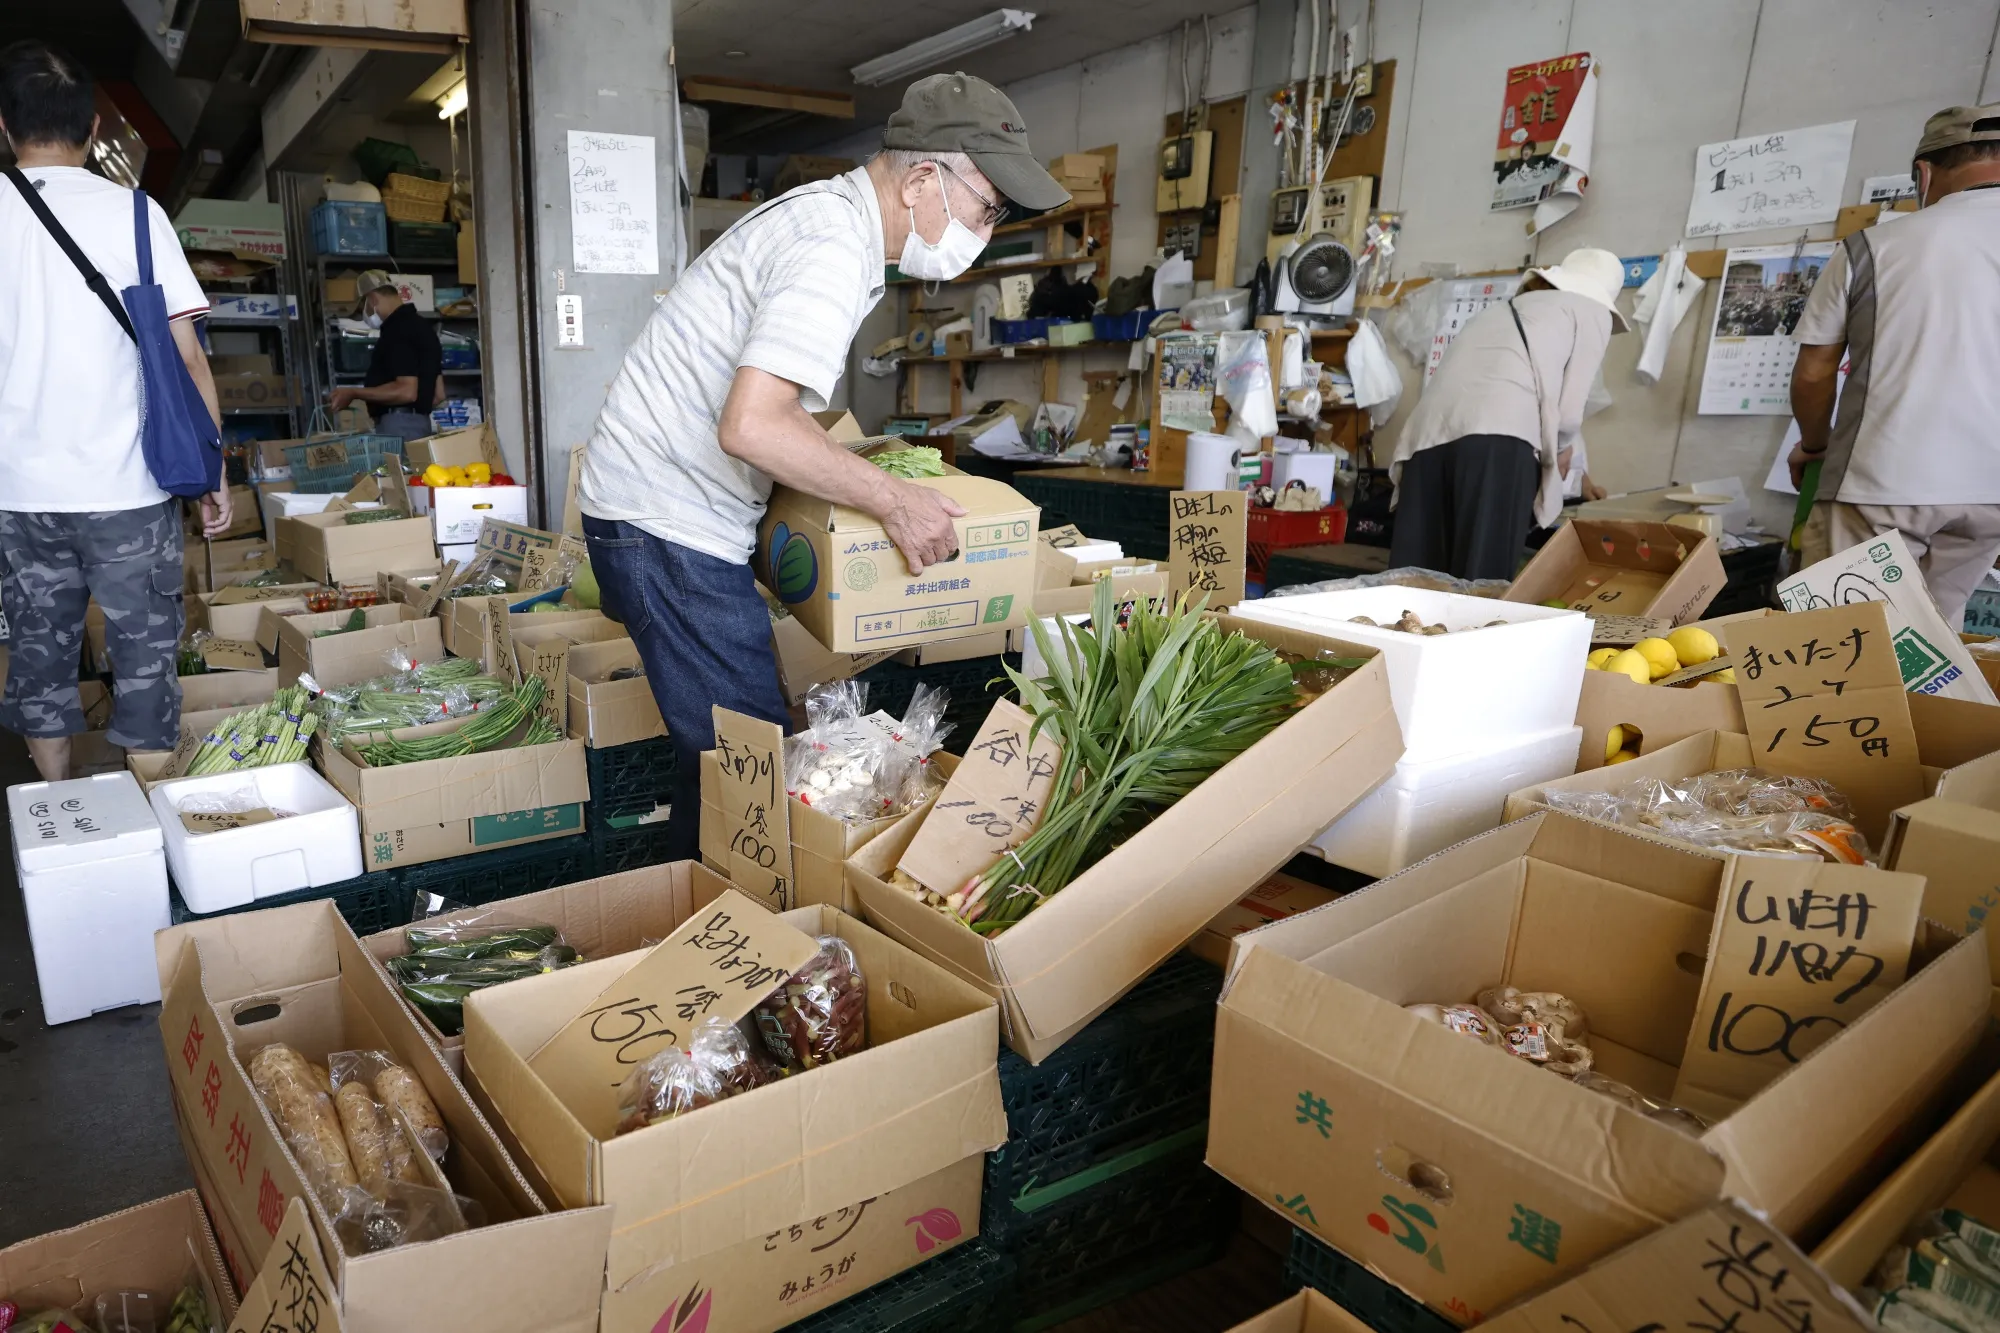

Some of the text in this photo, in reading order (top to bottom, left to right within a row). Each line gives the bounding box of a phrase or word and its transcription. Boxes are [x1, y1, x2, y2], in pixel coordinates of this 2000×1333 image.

[994, 528, 1003, 540] 8
[905, 577, 971, 596] 長井出荷組合
[863, 620, 894, 632] 生産者
[1742, 628, 1871, 680] まいたけ
[730, 828, 776, 868] 100
[778, 1251, 857, 1301] みょうが
